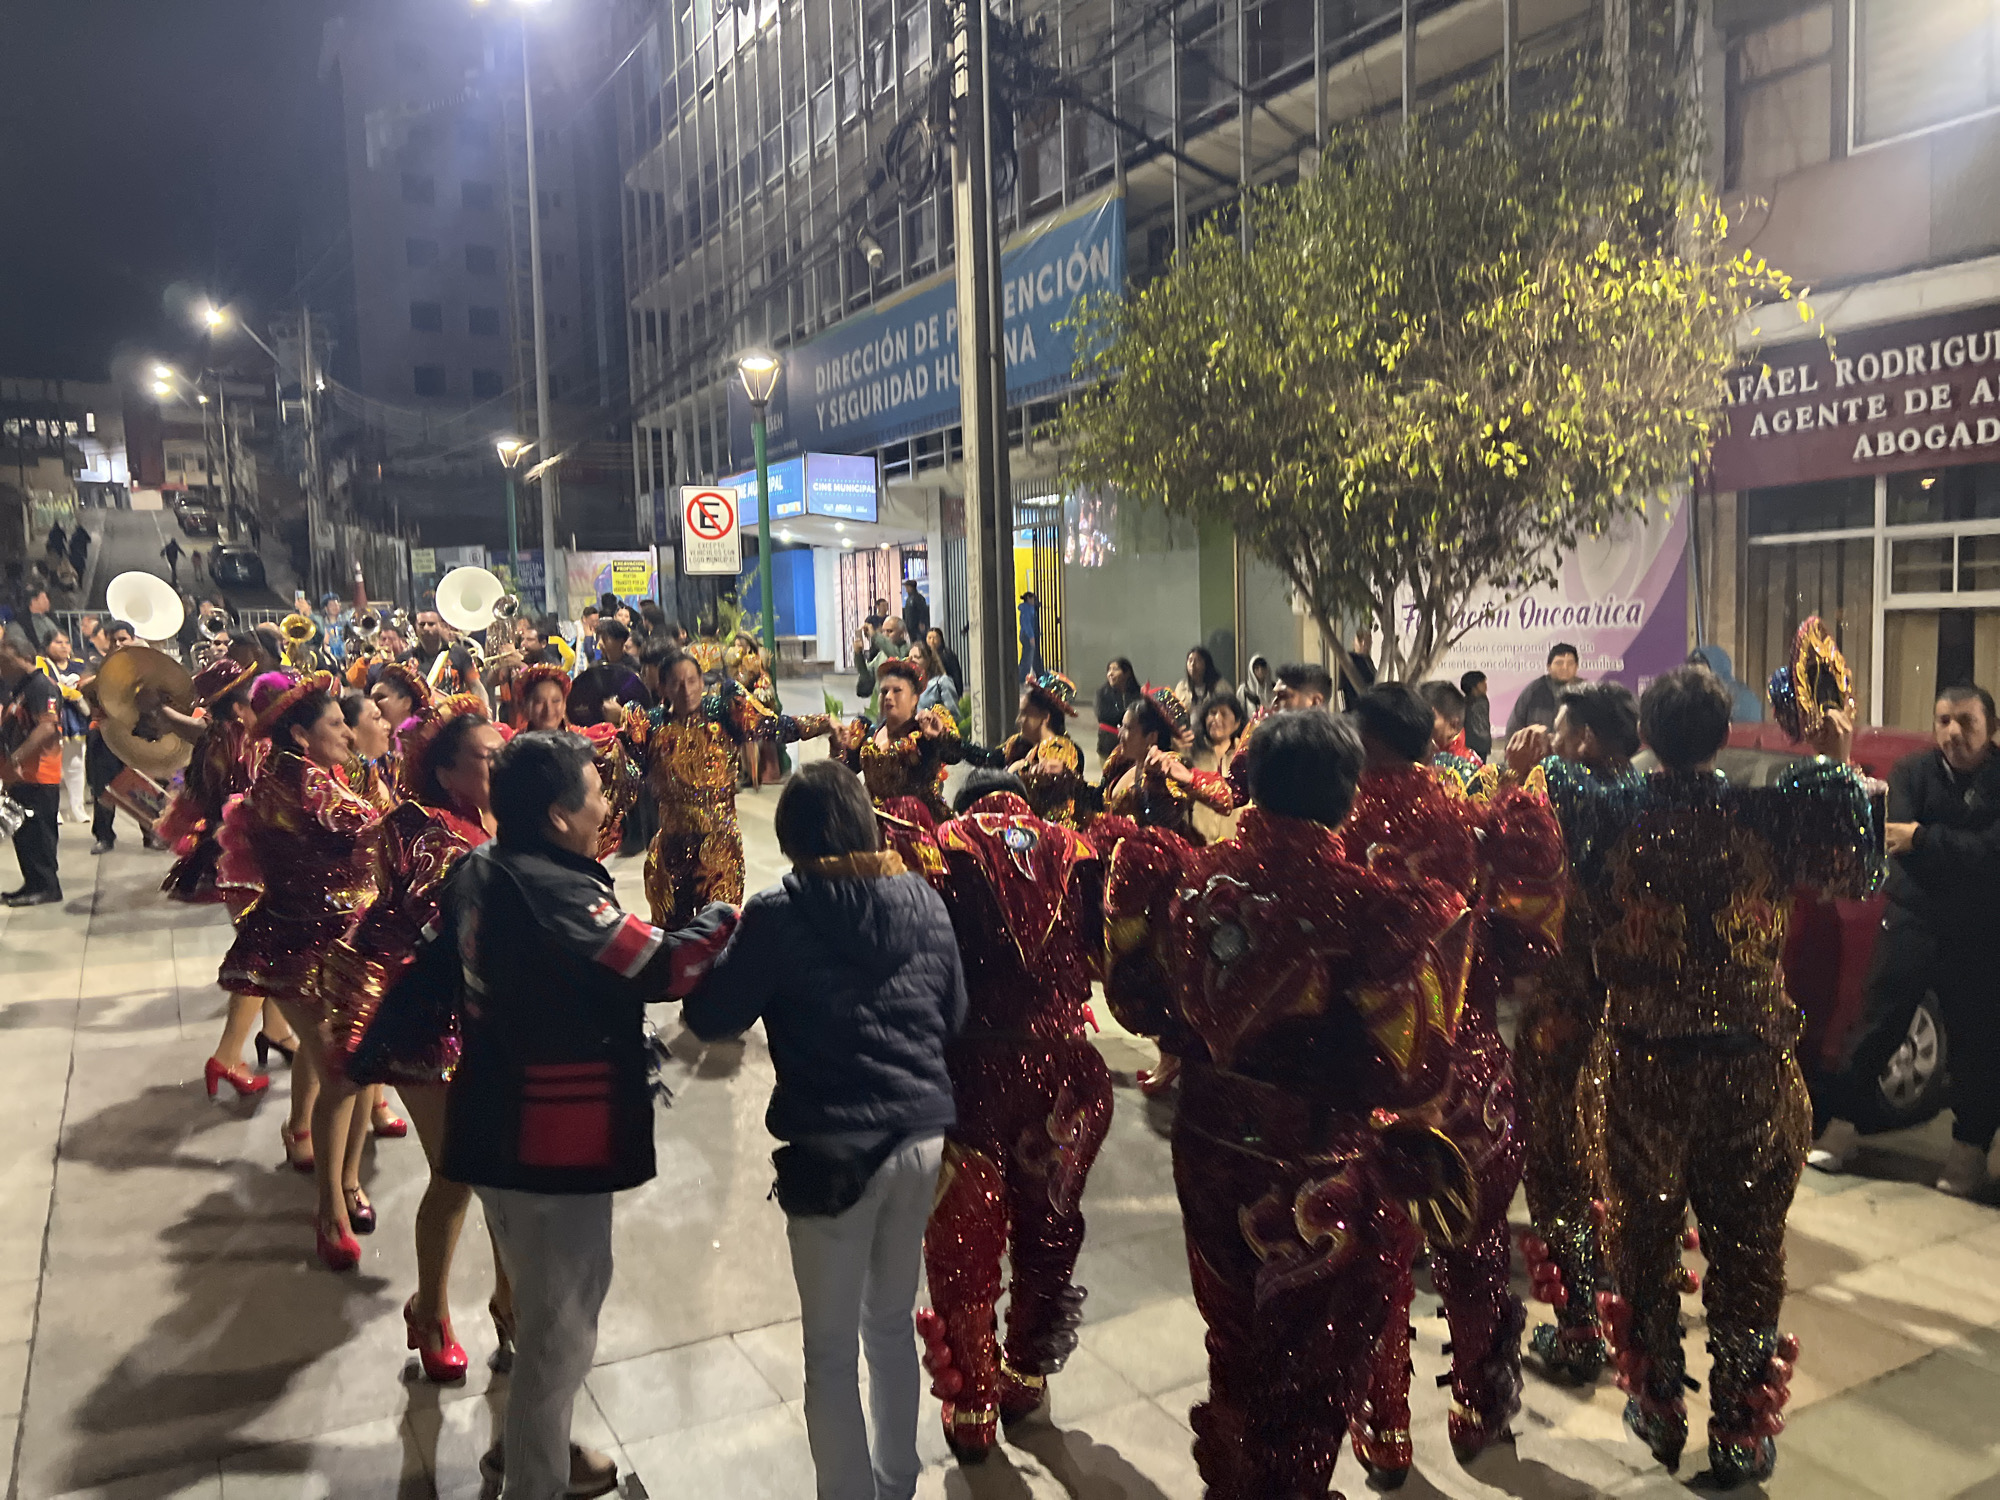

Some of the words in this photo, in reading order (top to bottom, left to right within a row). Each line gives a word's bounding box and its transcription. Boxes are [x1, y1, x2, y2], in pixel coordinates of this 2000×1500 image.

[815, 325, 908, 394] DIRECCIÓN
[914, 313, 939, 356] DE
[945, 238, 1110, 345] PENCIÓN
[816, 402, 825, 432] Y
[829, 364, 929, 428] SEGURIDAD
[935, 322, 1037, 392] HUNA
[1717, 364, 1819, 406] AFAEL
[1749, 393, 1888, 437] AGENTE
[1904, 383, 1952, 414] DE
[1969, 374, 2000, 405] A
[812, 482, 833, 492] CINE
[833, 483, 877, 495] MUNICIPAL
[1518, 596, 1642, 629] Oncoarica
[1480, 658, 1542, 672] oncológicos
